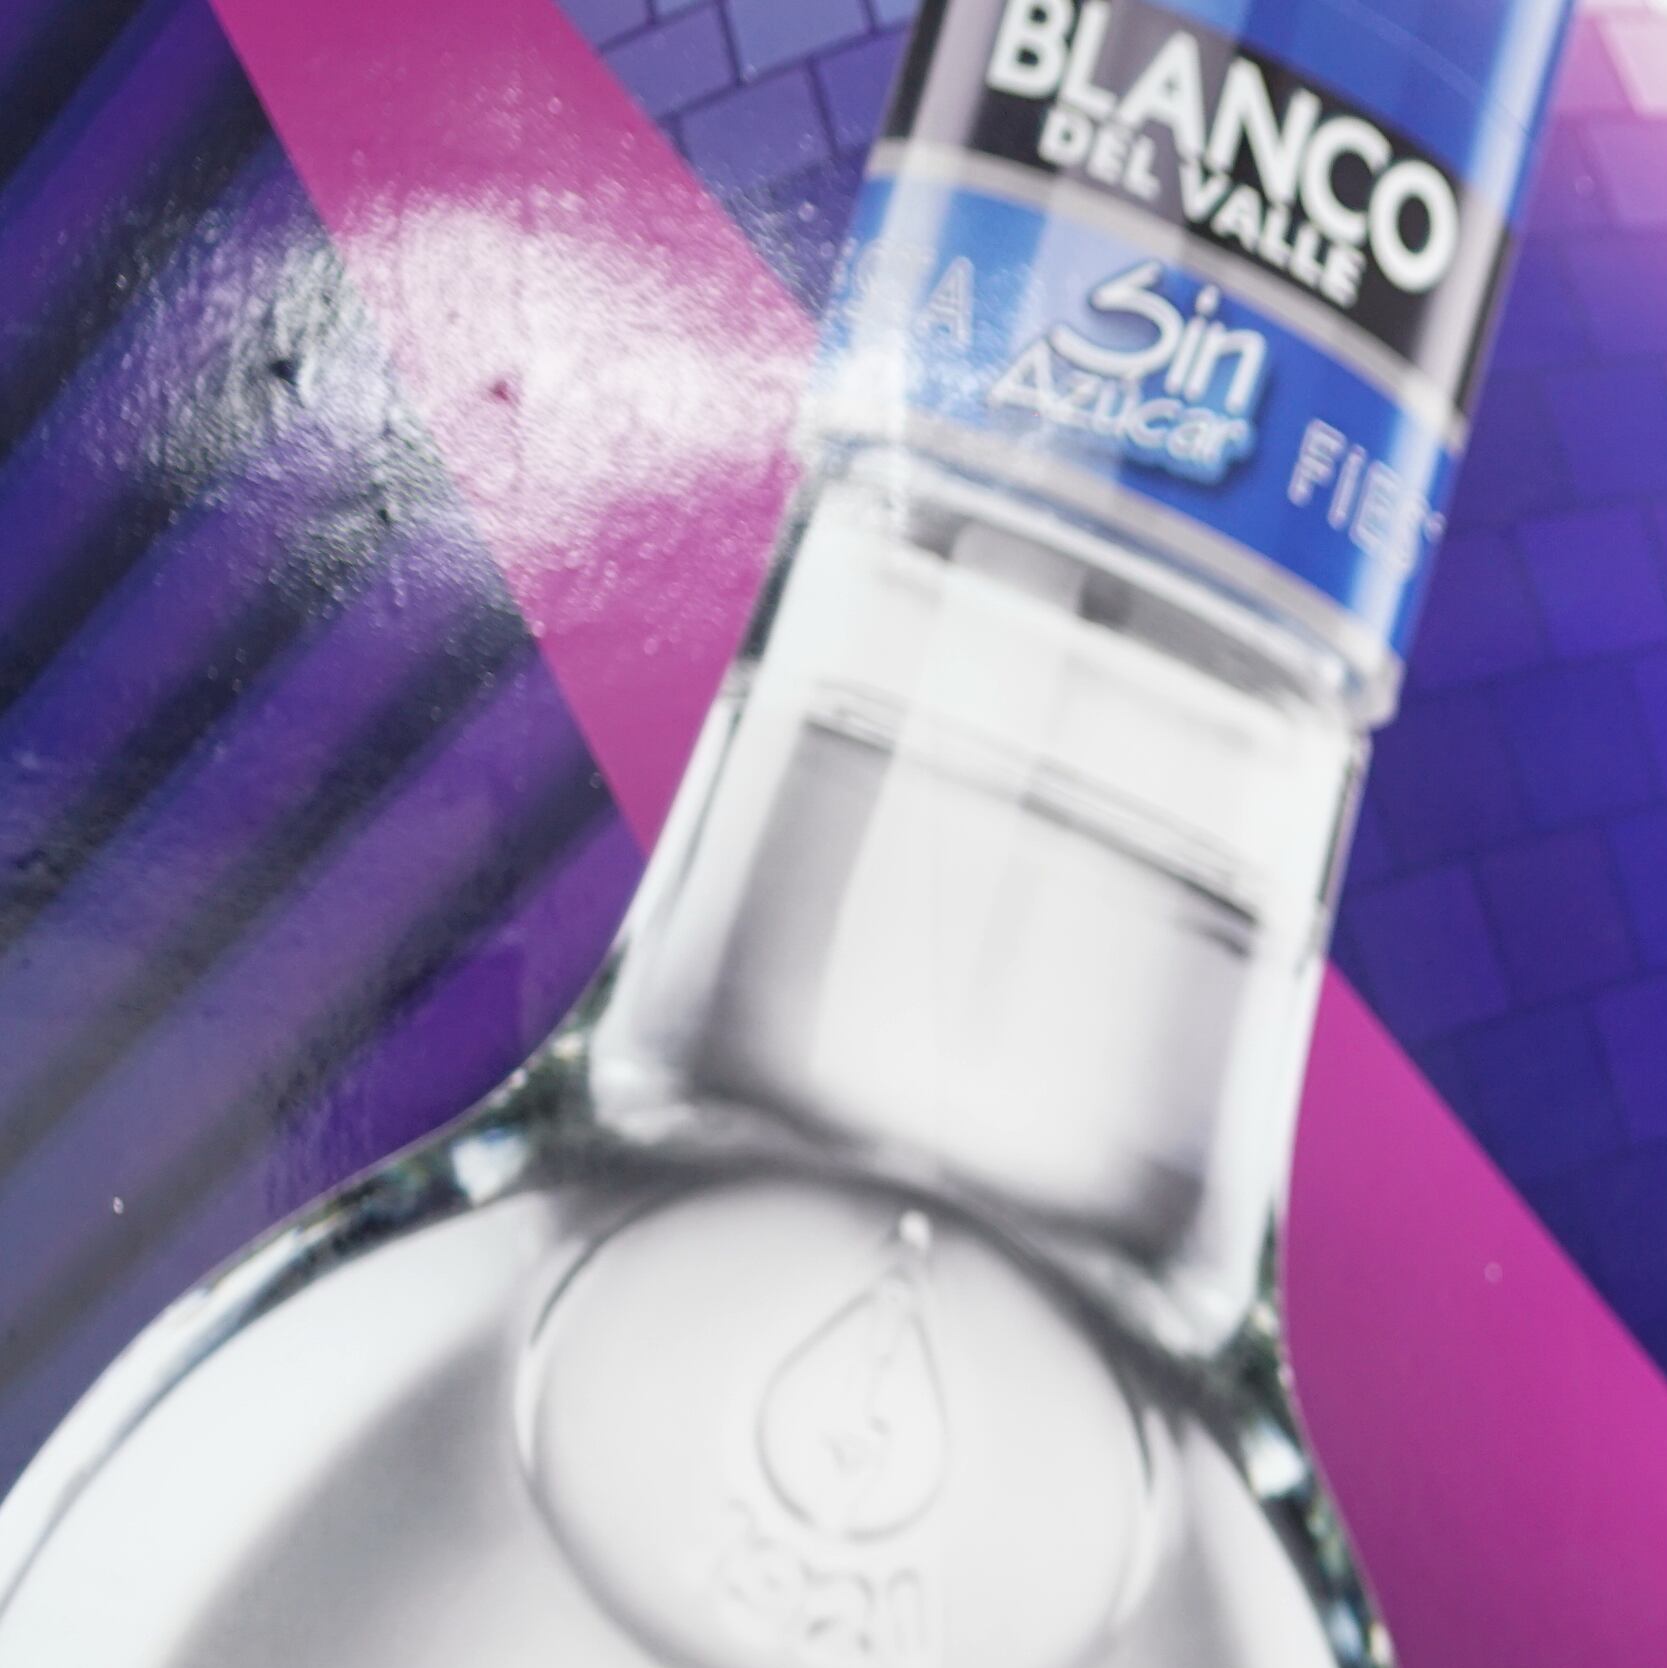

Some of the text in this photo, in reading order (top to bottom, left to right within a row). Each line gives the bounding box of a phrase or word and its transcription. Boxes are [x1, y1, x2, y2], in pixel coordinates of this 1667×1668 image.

[988, 0, 1460, 292] BLANCO
[1039, 108, 1364, 309] DEL VALLE
[1049, 260, 1266, 411] Sin
